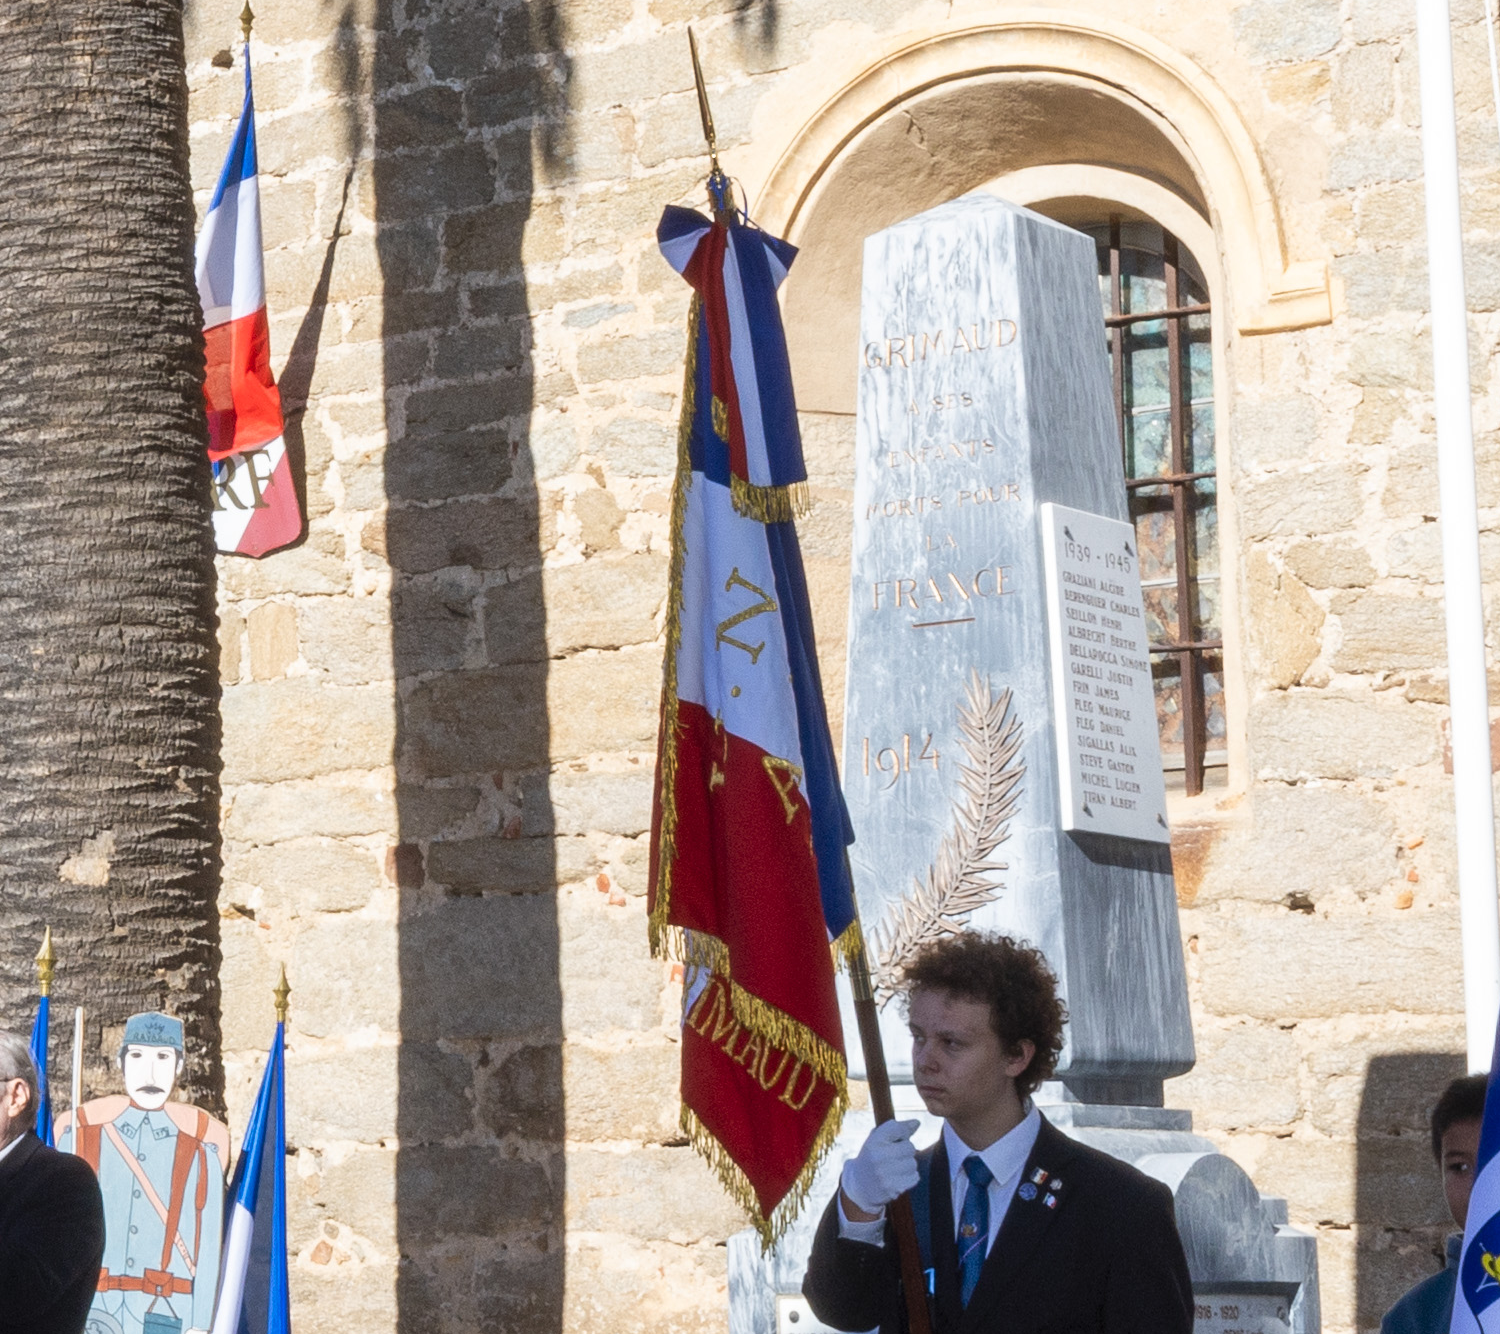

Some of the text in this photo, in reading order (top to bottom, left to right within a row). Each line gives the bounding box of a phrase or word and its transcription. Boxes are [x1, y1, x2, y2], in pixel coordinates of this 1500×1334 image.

[863, 319, 1017, 369] GRIMAUD
[932, 392, 973, 413] SES
[888, 438, 994, 468] ENFANTS
[866, 483, 1021, 520] MORTS POUR
[926, 534, 957, 552] LA
[1064, 542, 1091, 562] 1939
[1104, 553, 1131, 573] 1945
[872, 566, 1016, 610] FRANCE
[1068, 625, 1106, 644] ALBRECHT
[863, 732, 940, 791] 1914
[686, 978, 817, 1110] IMAUD
